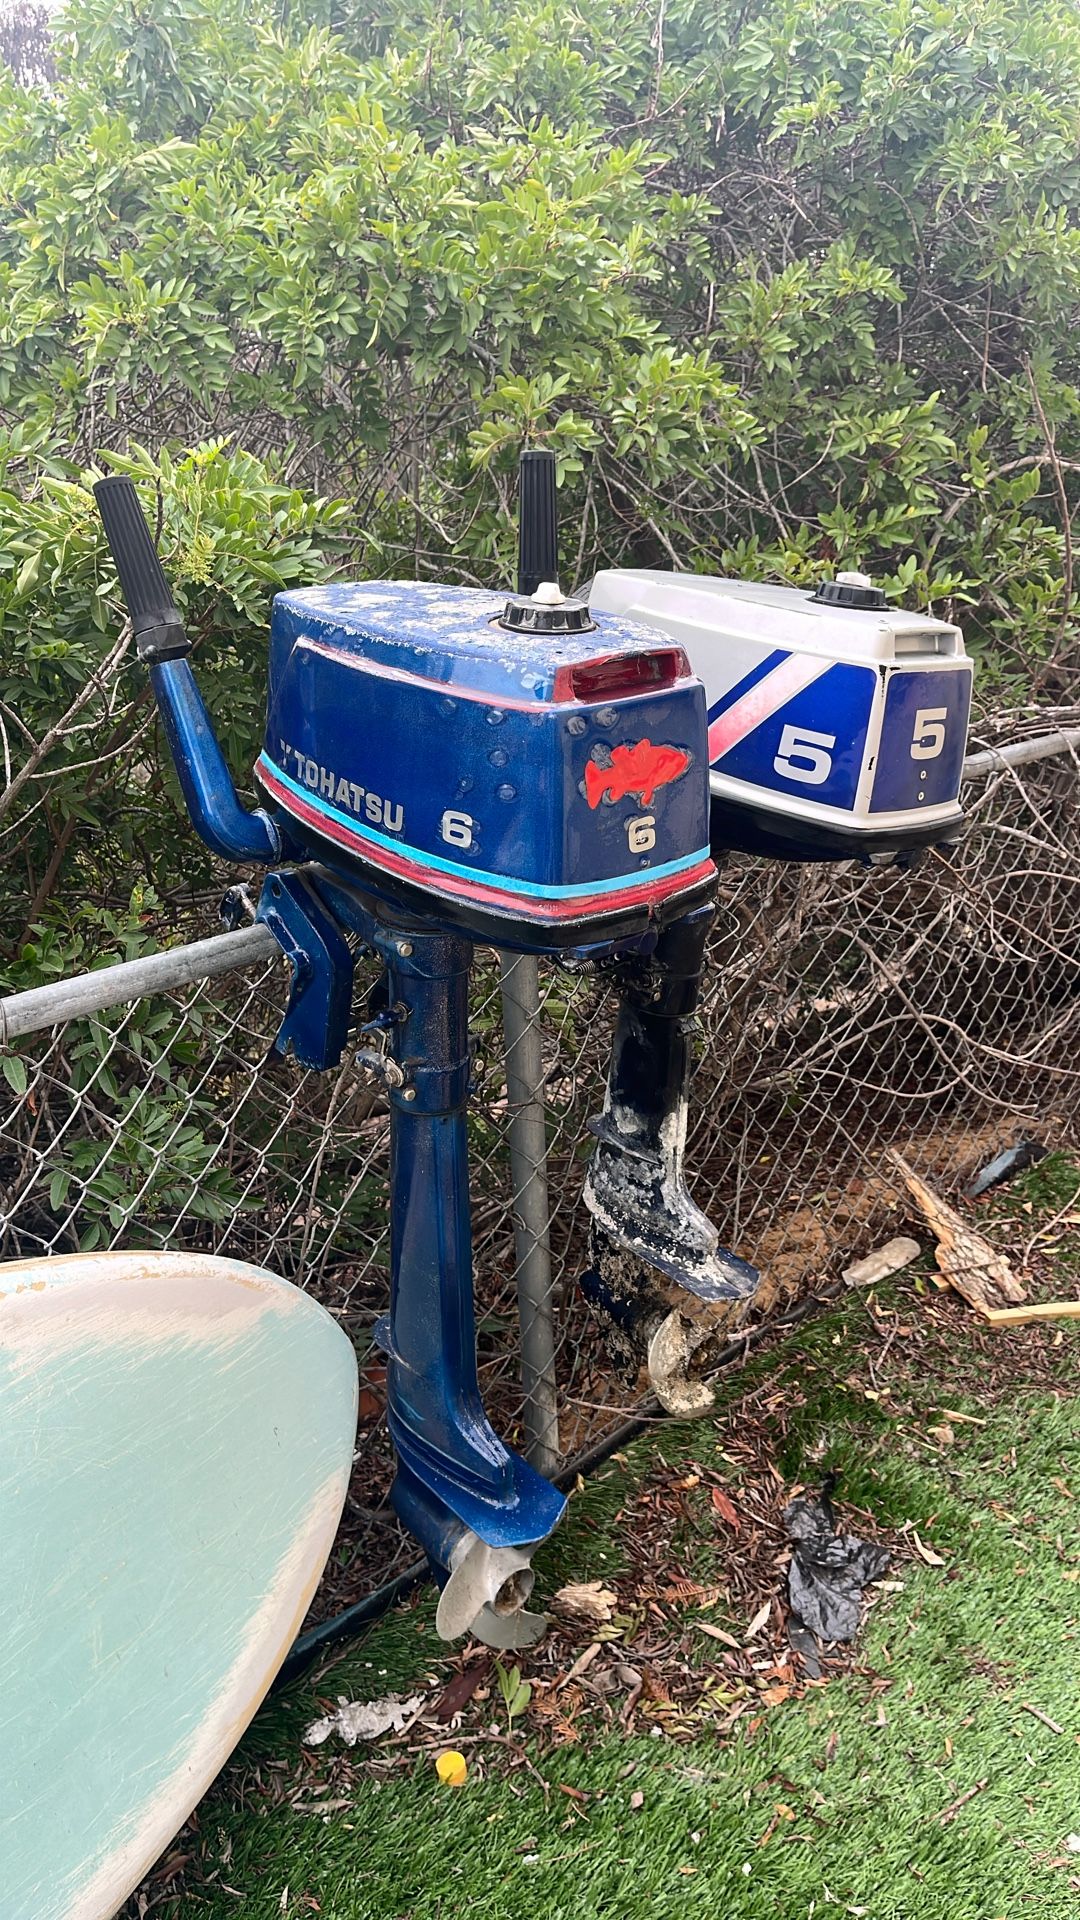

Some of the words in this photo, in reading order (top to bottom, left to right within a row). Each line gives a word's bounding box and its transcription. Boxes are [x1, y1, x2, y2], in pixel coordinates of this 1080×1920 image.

[773, 724, 836, 785] 5
[910, 707, 947, 760] 5
[294, 750, 404, 832] TOHATSU
[442, 810, 473, 848] 6
[628, 815, 656, 854] 6
